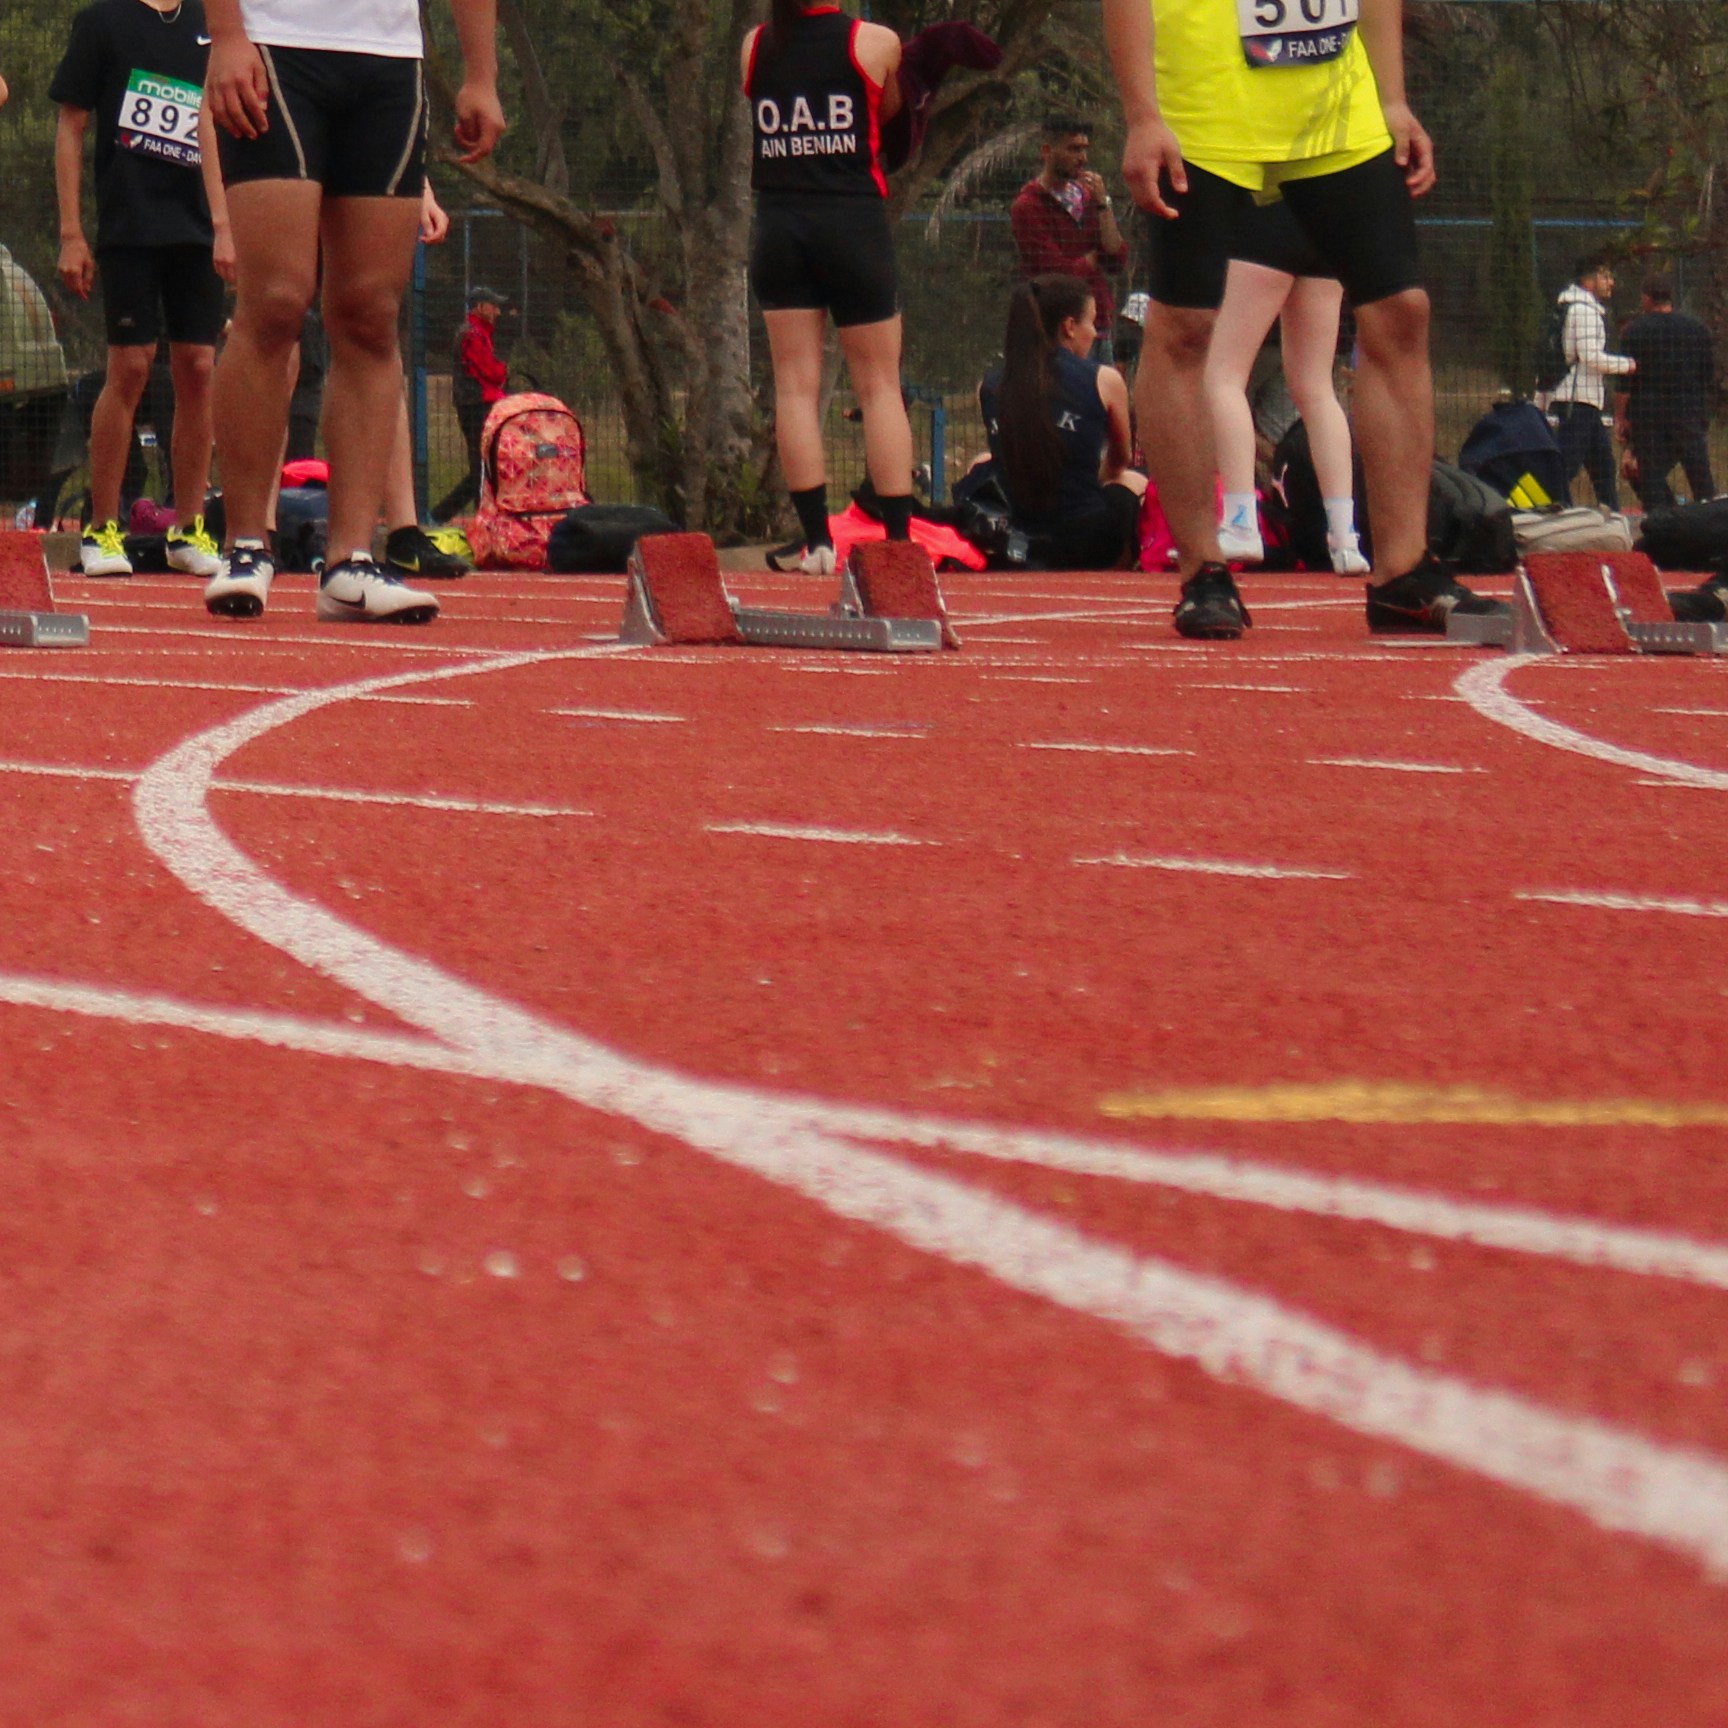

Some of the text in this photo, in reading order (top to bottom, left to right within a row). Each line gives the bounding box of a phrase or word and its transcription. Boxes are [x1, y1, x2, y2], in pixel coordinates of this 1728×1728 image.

[1288, 39, 1318, 58] FAA
[1319, 36, 1338, 54] ONE
[131, 98, 199, 141] 892
[758, 94, 854, 134] O.A.B
[144, 139, 162, 154] FAA
[163, 143, 182, 159] ONE
[762, 134, 856, 158] AIN BENIAN
